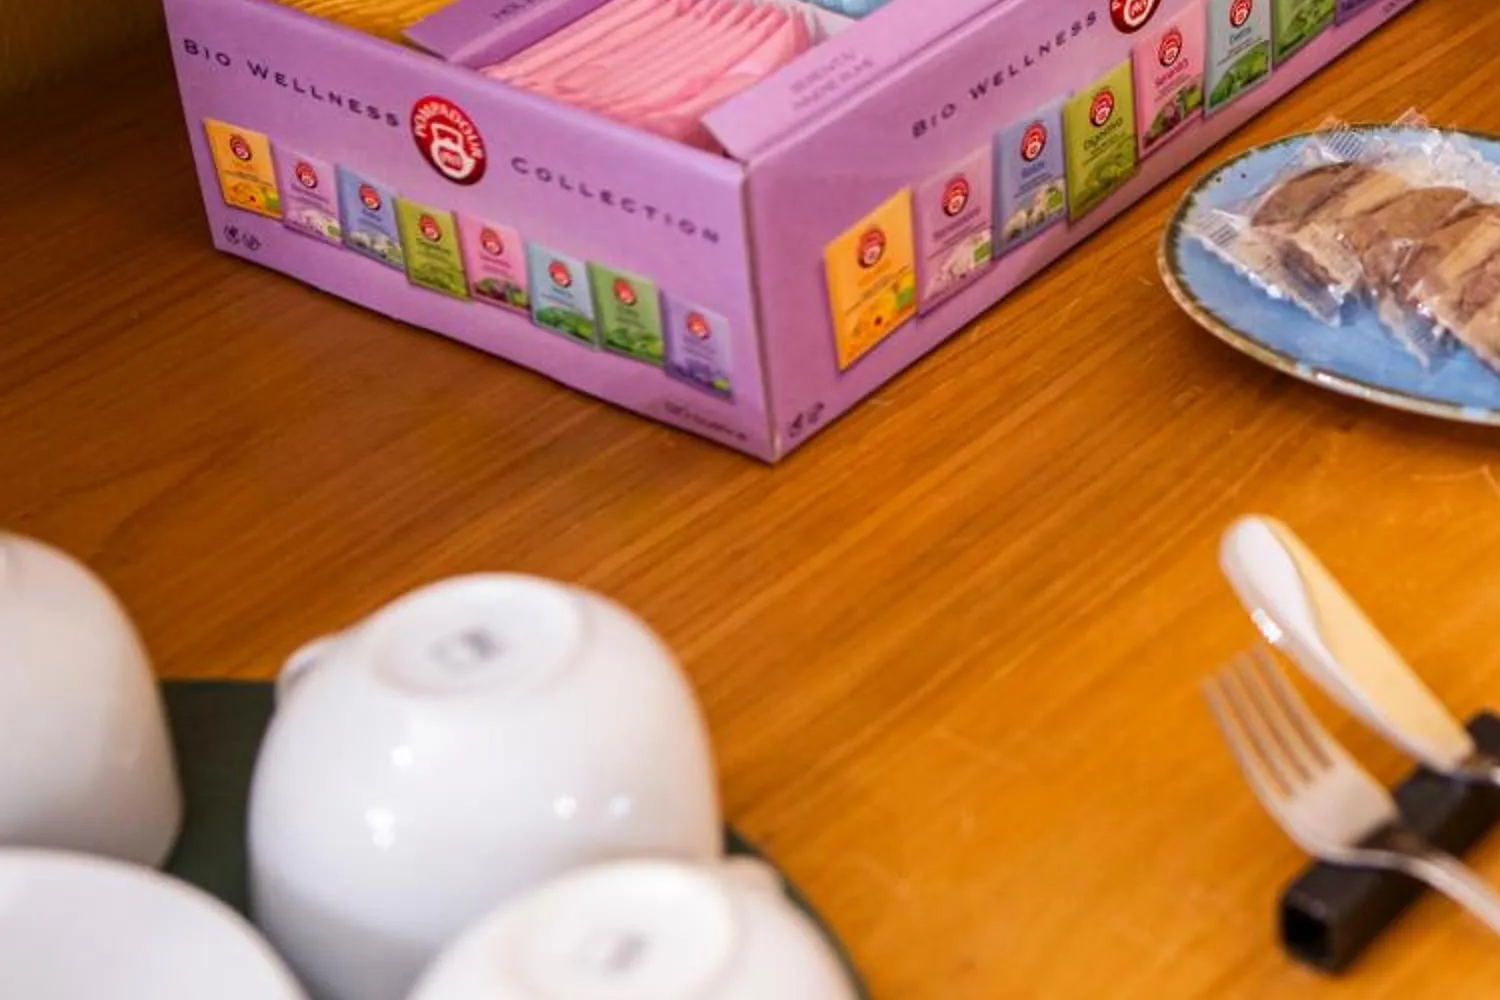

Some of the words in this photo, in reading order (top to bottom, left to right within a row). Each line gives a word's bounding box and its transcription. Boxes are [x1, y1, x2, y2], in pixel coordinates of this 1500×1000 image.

[183, 38, 231, 67] BIO
[246, 60, 400, 127] WELLNESS
[911, 103, 957, 139] BIO
[969, 11, 1097, 101] WELLNESS
[510, 156, 720, 244] COLLECTION
